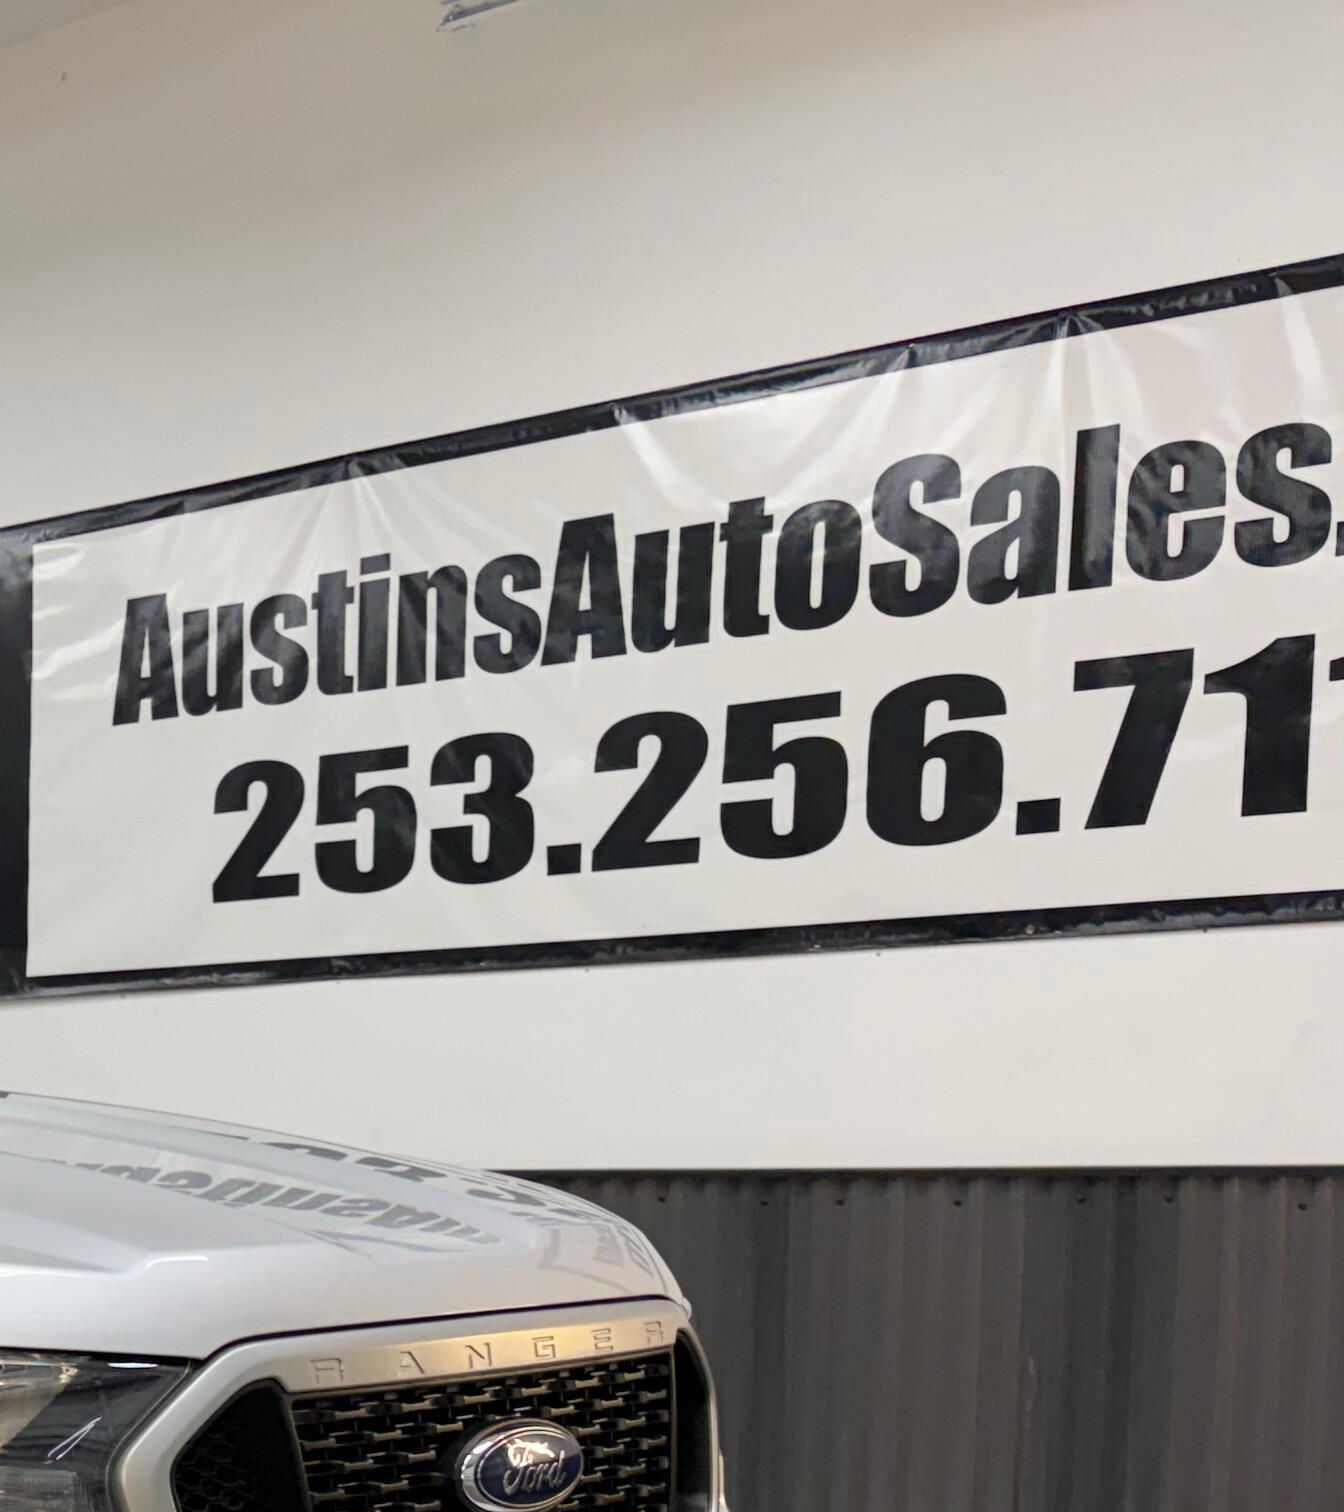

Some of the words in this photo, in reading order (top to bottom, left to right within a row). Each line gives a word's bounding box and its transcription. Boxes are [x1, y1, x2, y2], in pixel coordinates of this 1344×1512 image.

[112, 422, 1344, 727] AustinsAutoSales
[212, 633, 1344, 904] 253.256.71
[309, 1320, 666, 1385] RANGER
[502, 1437, 567, 1494] Ford
